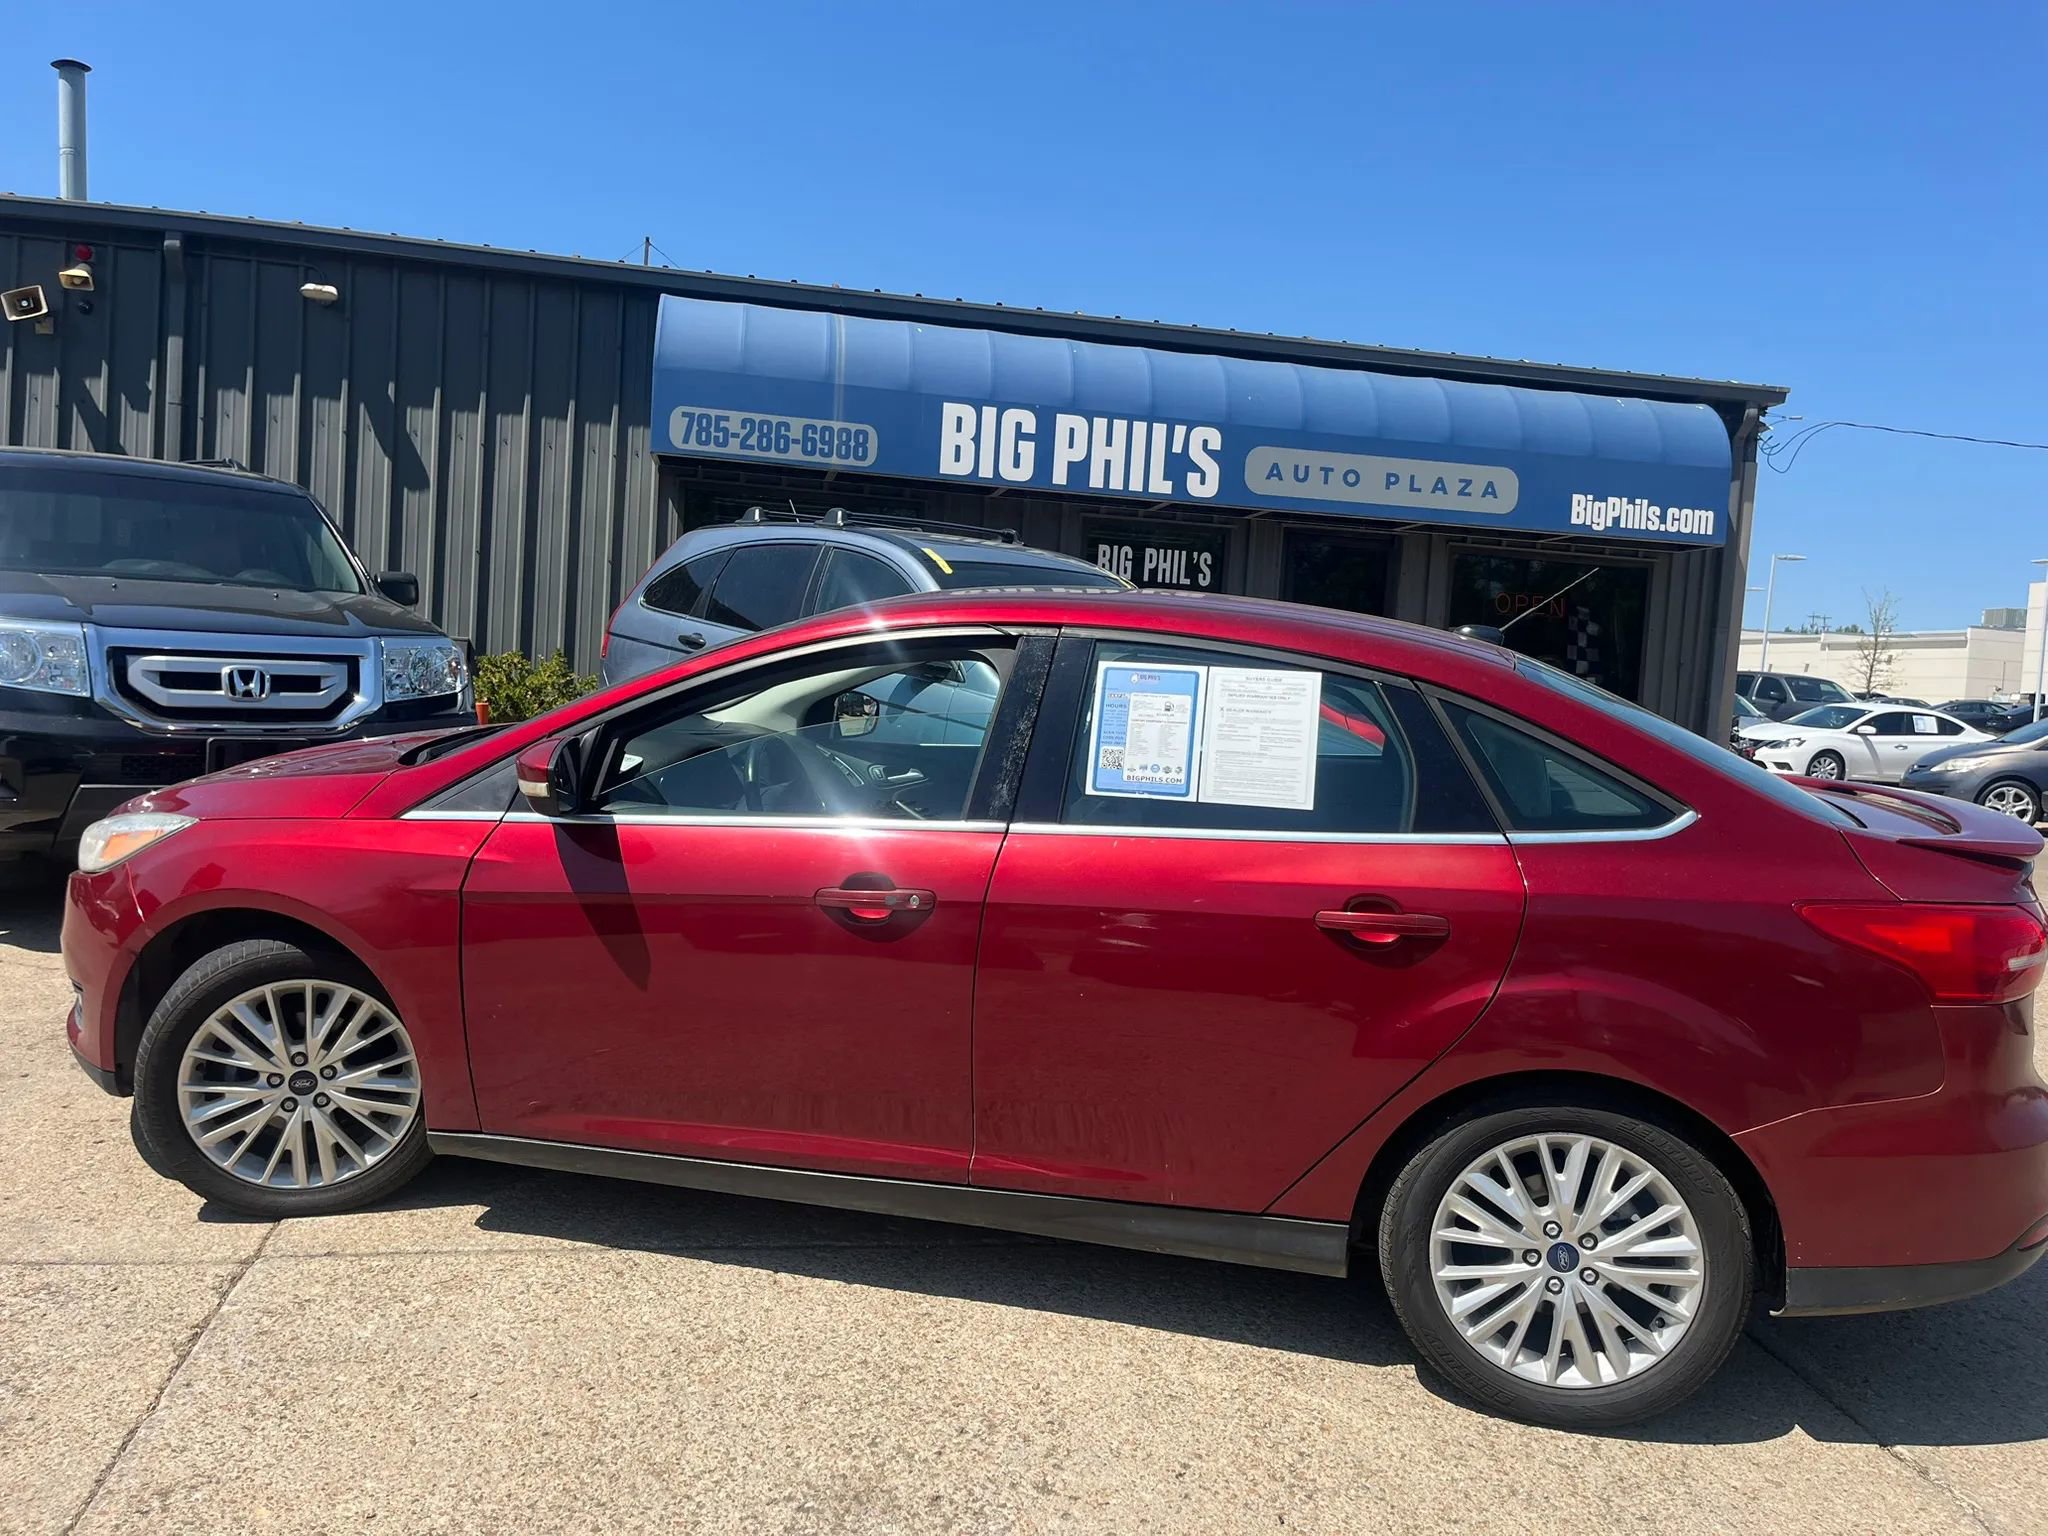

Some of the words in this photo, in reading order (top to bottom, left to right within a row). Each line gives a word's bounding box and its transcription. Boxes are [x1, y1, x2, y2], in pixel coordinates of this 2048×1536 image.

[681, 411, 869, 462] 785-286-6988
[939, 402, 1037, 482] BIG
[1052, 413, 1222, 498] PHIL'S
[1265, 462, 1361, 488] AUTO
[1385, 472, 1499, 499] PLAZA
[1570, 493, 1715, 535] BigPhils.com
[1097, 544, 1133, 580] BIG
[1143, 547, 1212, 587] PHIL'S
[1495, 592, 1566, 619] OPEN
[1126, 775, 1183, 784] BIGPHILS.COM
